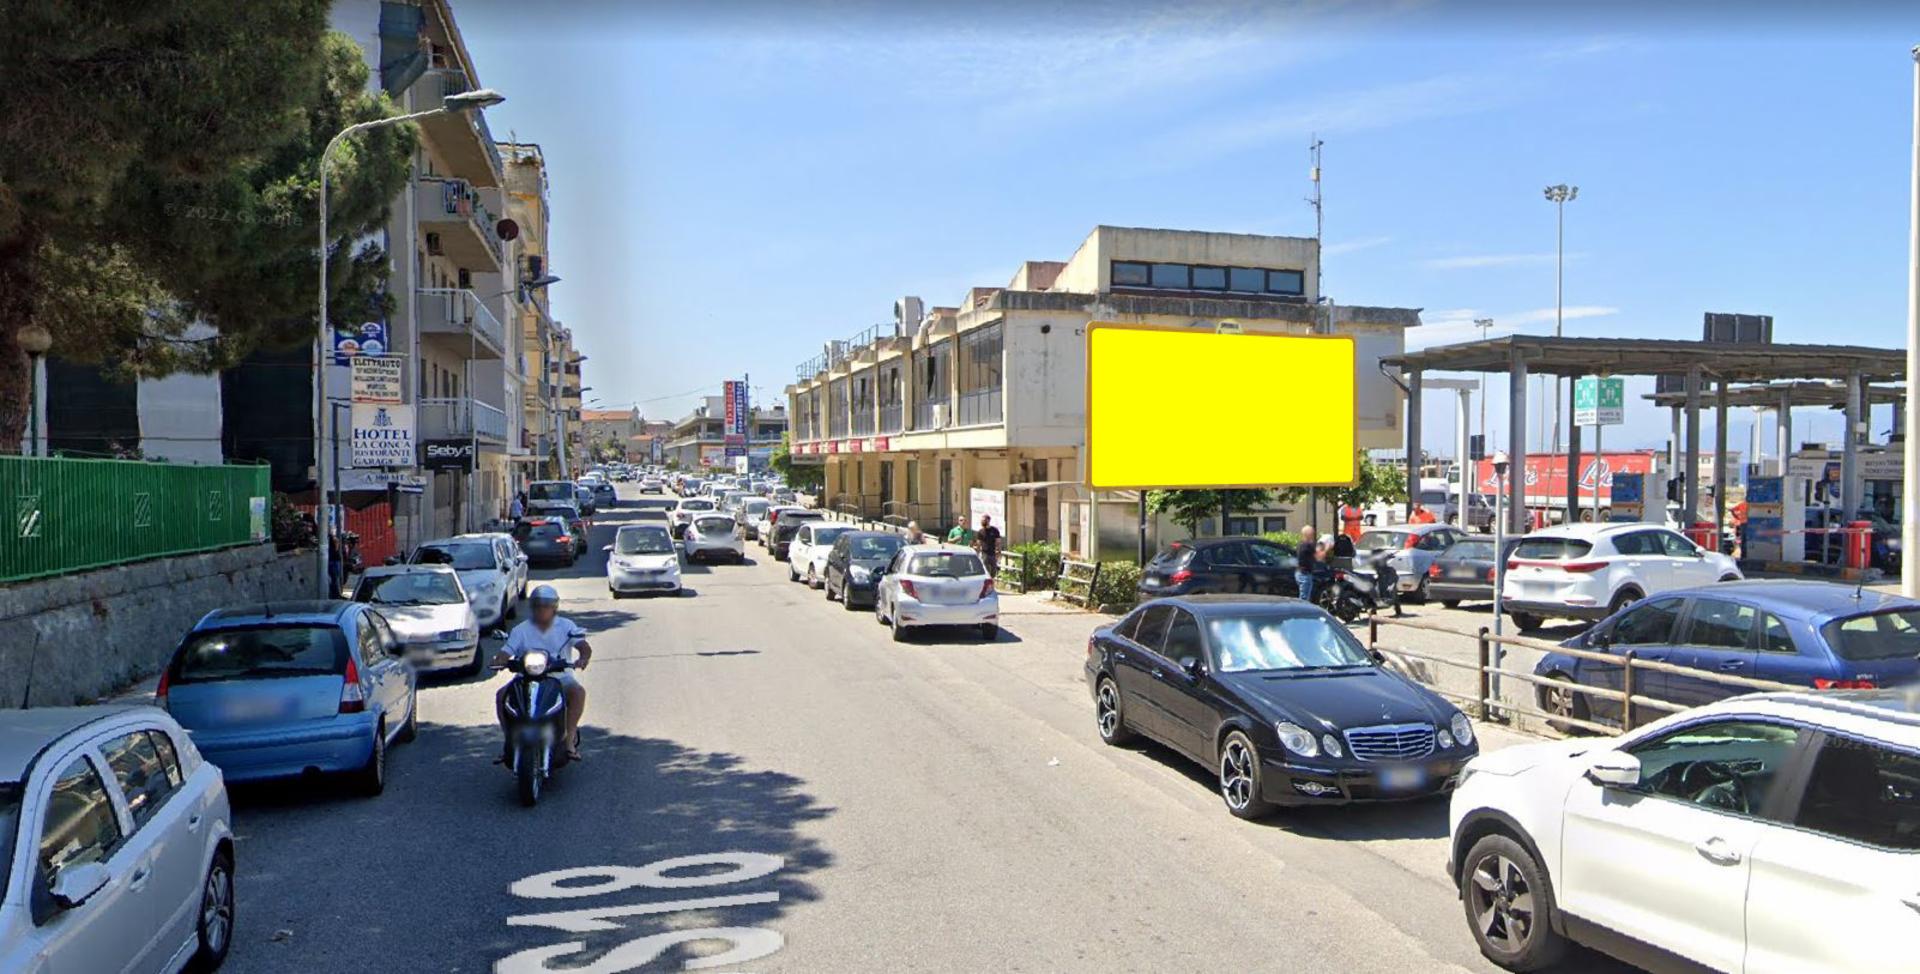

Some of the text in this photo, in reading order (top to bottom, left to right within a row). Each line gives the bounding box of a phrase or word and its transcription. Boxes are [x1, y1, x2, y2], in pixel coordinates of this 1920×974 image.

[354, 428, 411, 440] HOTEL
[354, 441, 411, 449] LA CONCA
